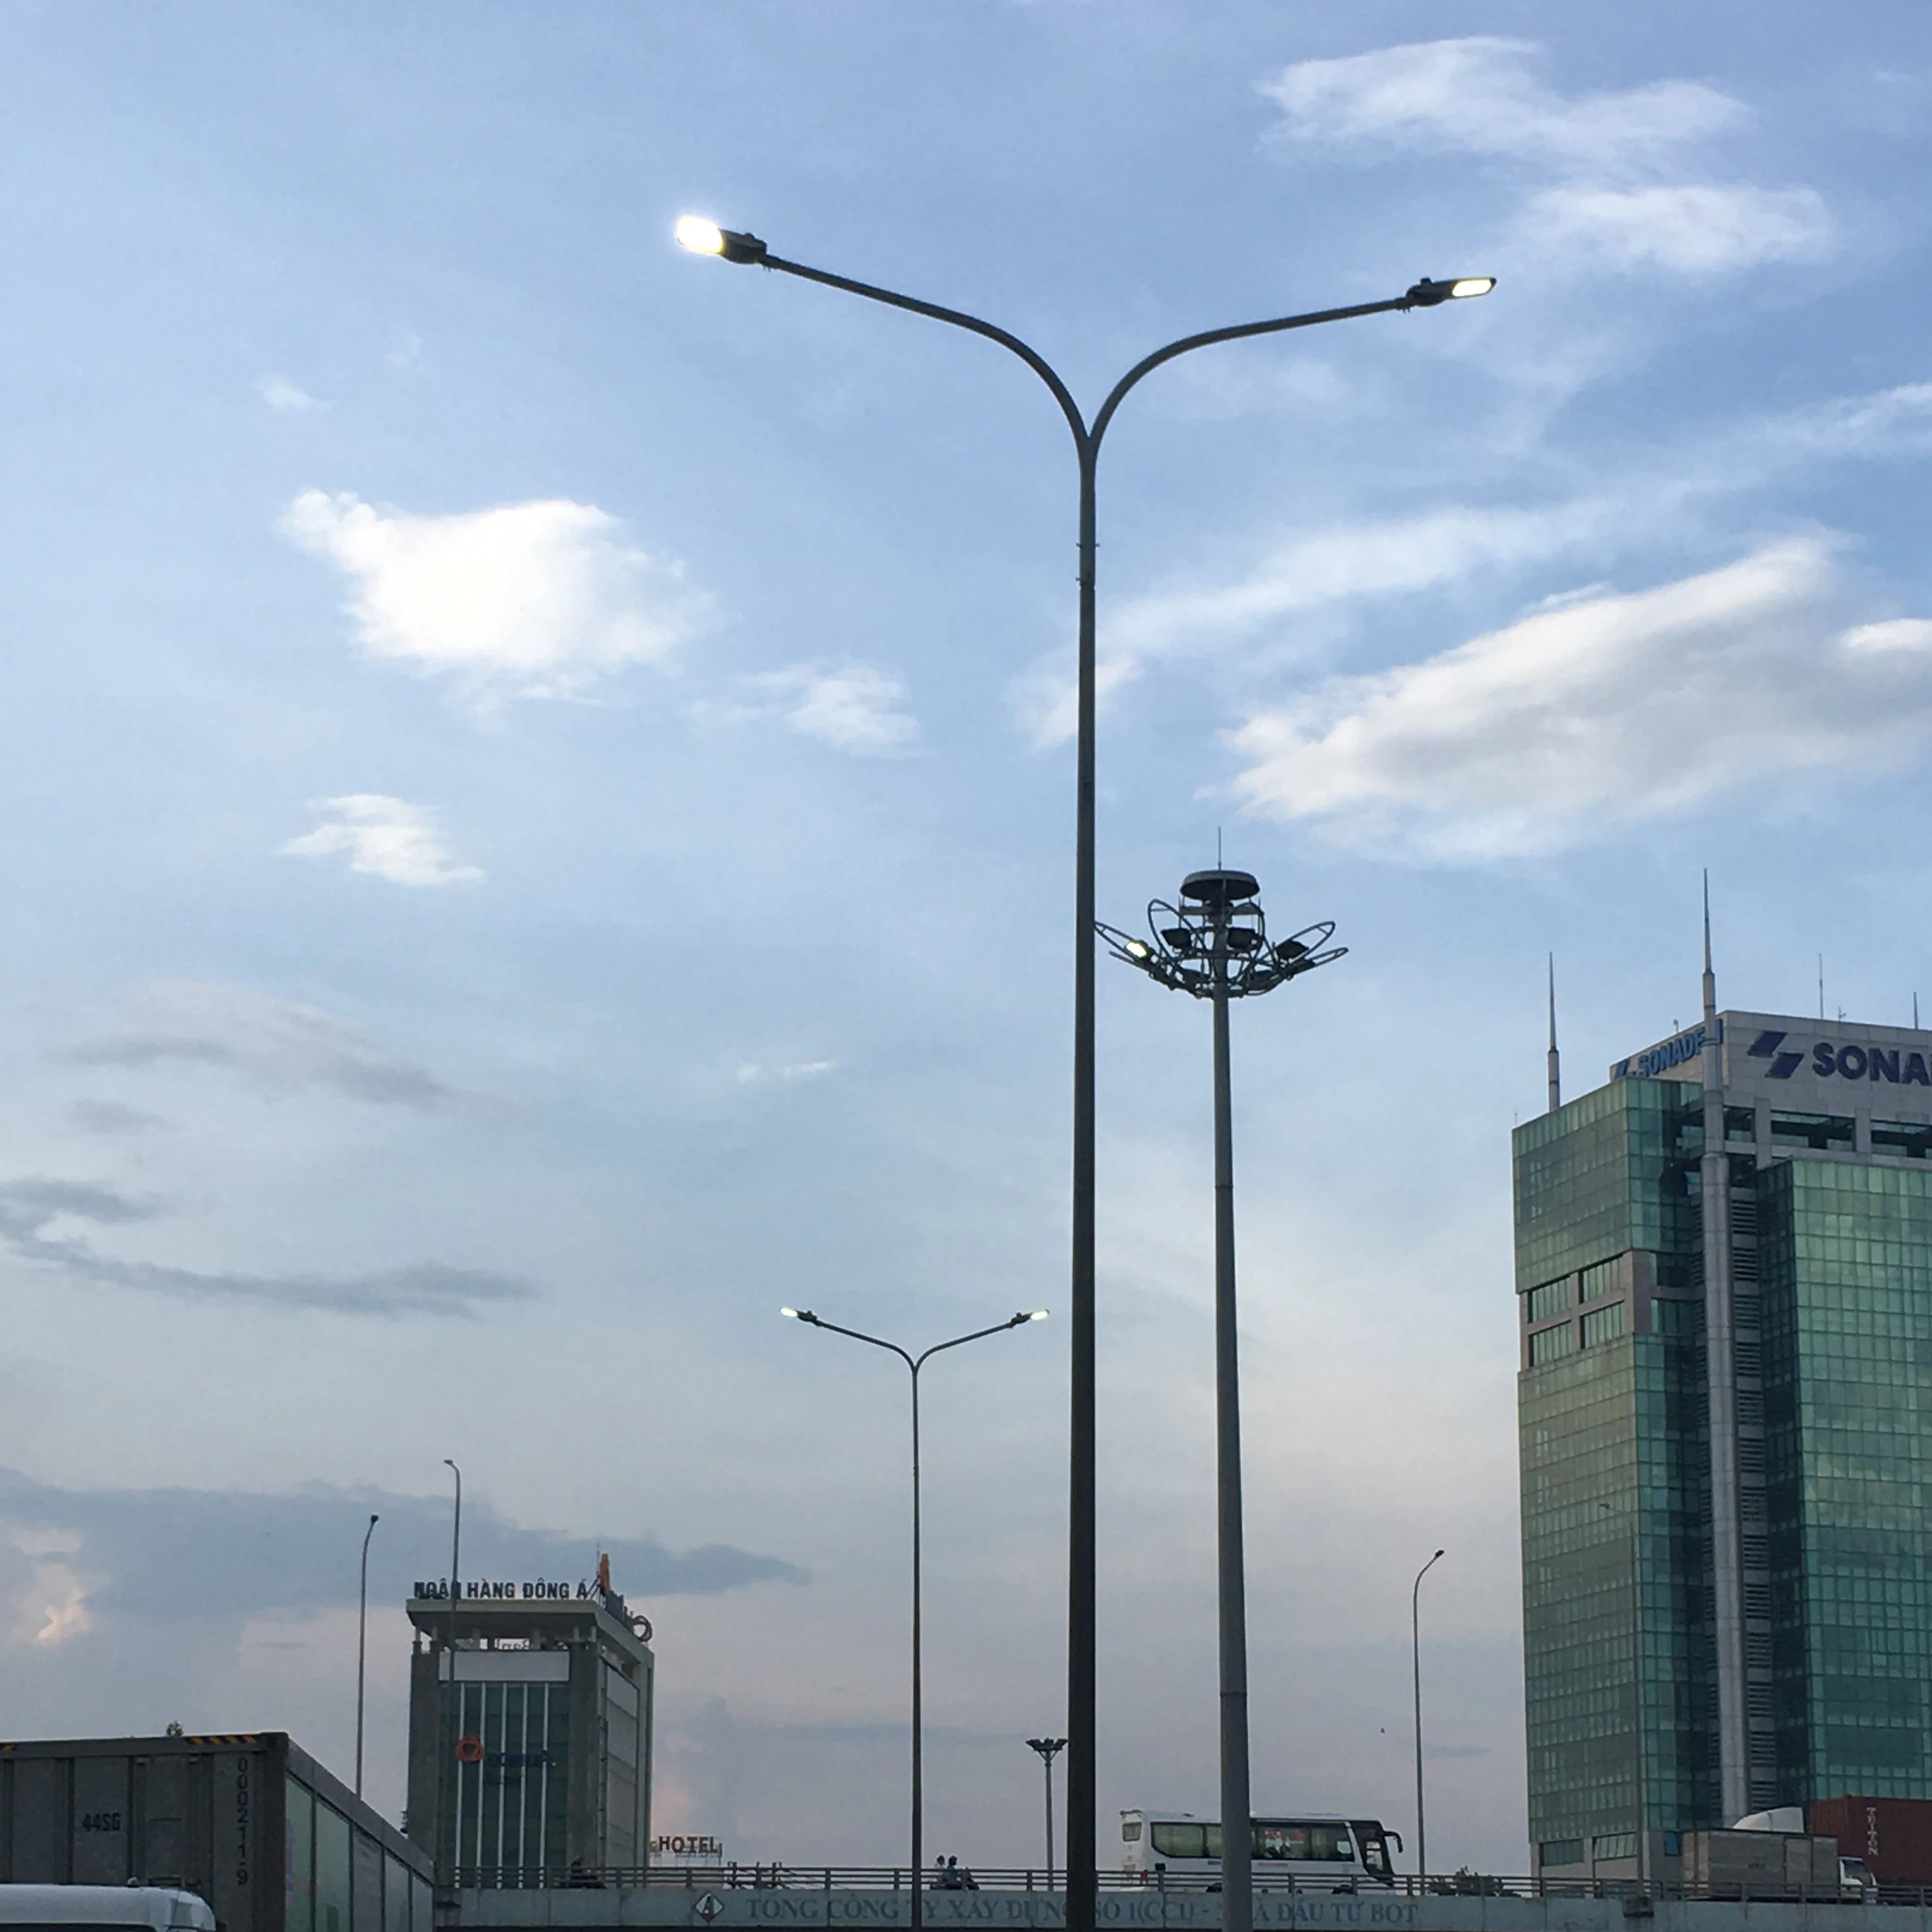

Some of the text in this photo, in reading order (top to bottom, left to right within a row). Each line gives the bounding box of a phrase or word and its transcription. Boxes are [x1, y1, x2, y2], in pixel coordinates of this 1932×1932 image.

[1639, 1018, 1723, 1077] SONADEI
[1812, 1041, 1932, 1086] SONA
[467, 1578, 515, 1598] HÀNG
[522, 1577, 570, 1598] ĐÔNG
[577, 1578, 588, 1600] Á
[658, 1836, 718, 1853] HOTEL
[827, 1893, 899, 1919] CÔNG
[946, 1893, 998, 1919] XÂY
[1331, 1901, 1365, 1922] TƯ
[1370, 1903, 1418, 1923] BOT
